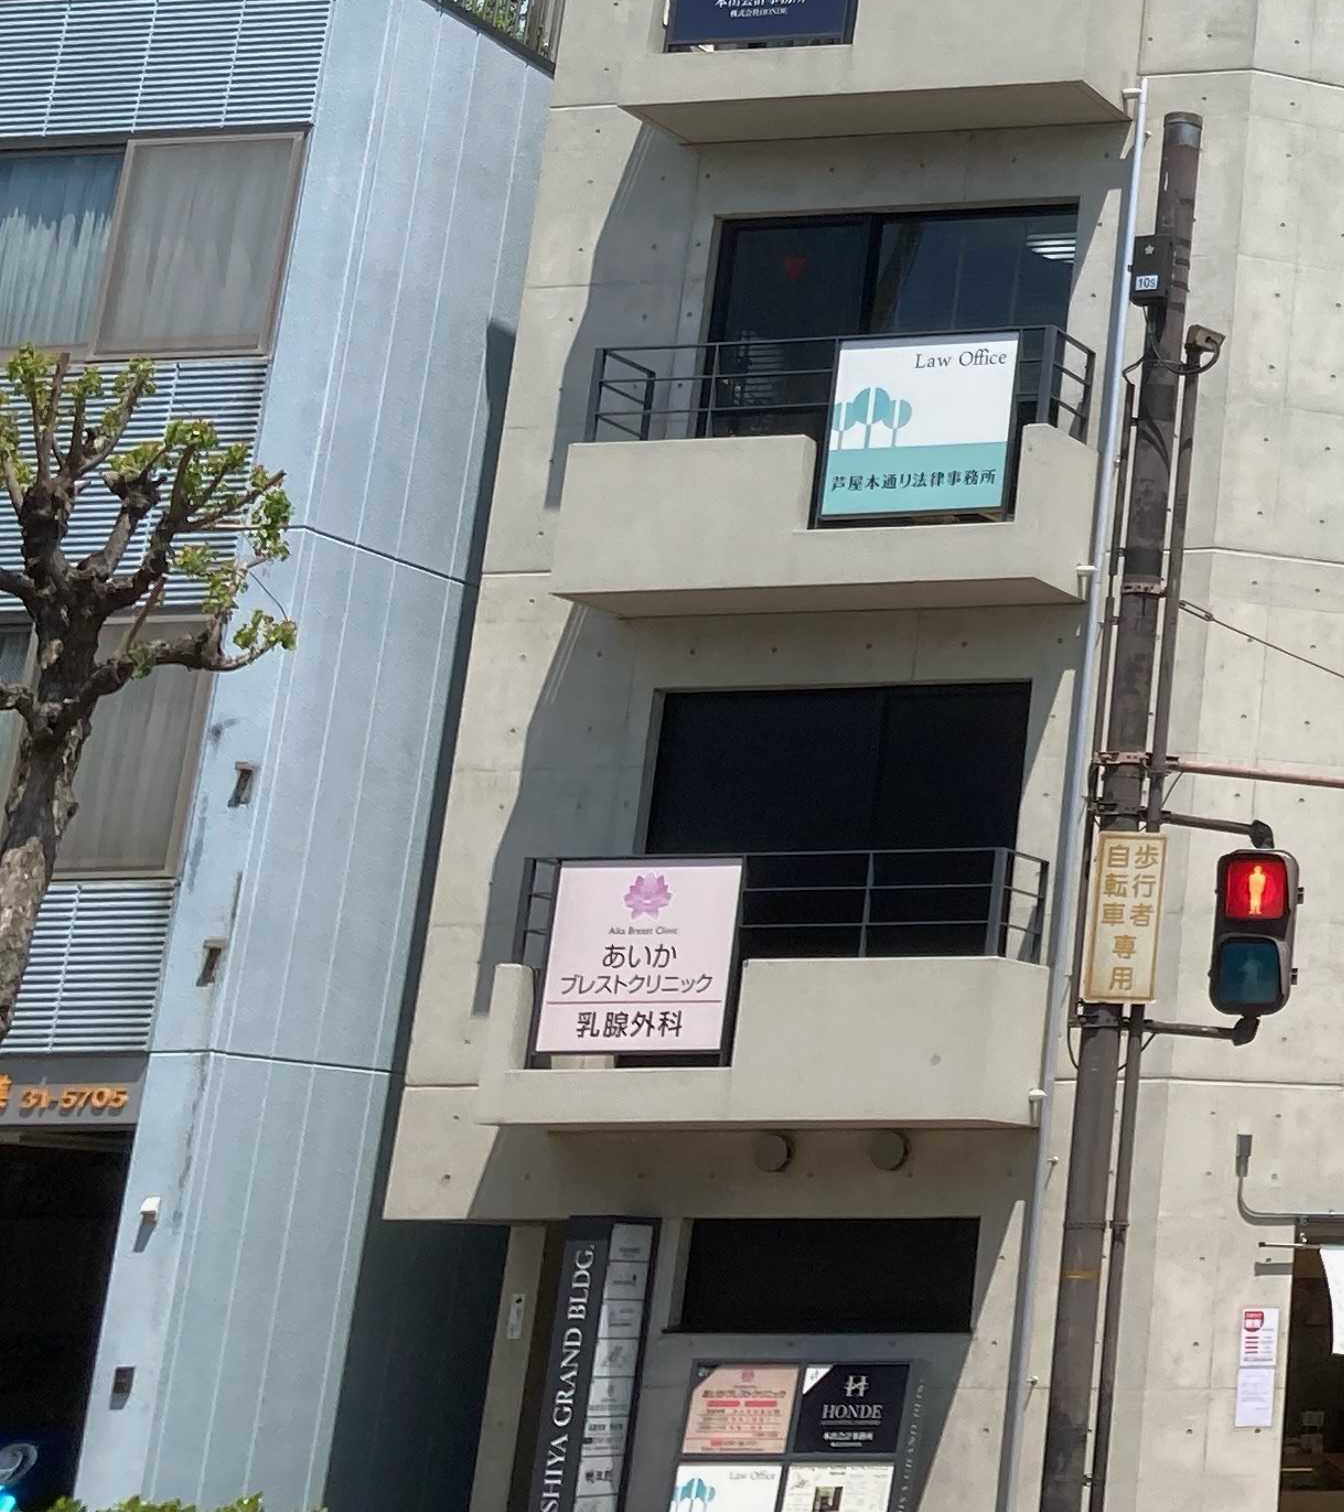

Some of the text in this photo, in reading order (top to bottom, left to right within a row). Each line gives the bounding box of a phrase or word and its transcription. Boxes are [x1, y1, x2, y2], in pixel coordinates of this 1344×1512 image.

[915, 348, 1008, 369] Law Office
[831, 468, 997, 492] 芦屋本通り法律事務所
[1101, 844, 1130, 927] 自転車
[1129, 844, 1159, 928] 歩行者
[602, 944, 677, 969] あいか
[1109, 934, 1136, 991] 専用
[560, 974, 713, 995] ブレストクリニック
[576, 1011, 683, 1038] 乳腺外科
[567, 1243, 596, 1321] BLDG.
[552, 1326, 583, 1428] GRAND
[822, 1404, 883, 1419] HONDE
[729, 1469, 777, 1480] Law Office
